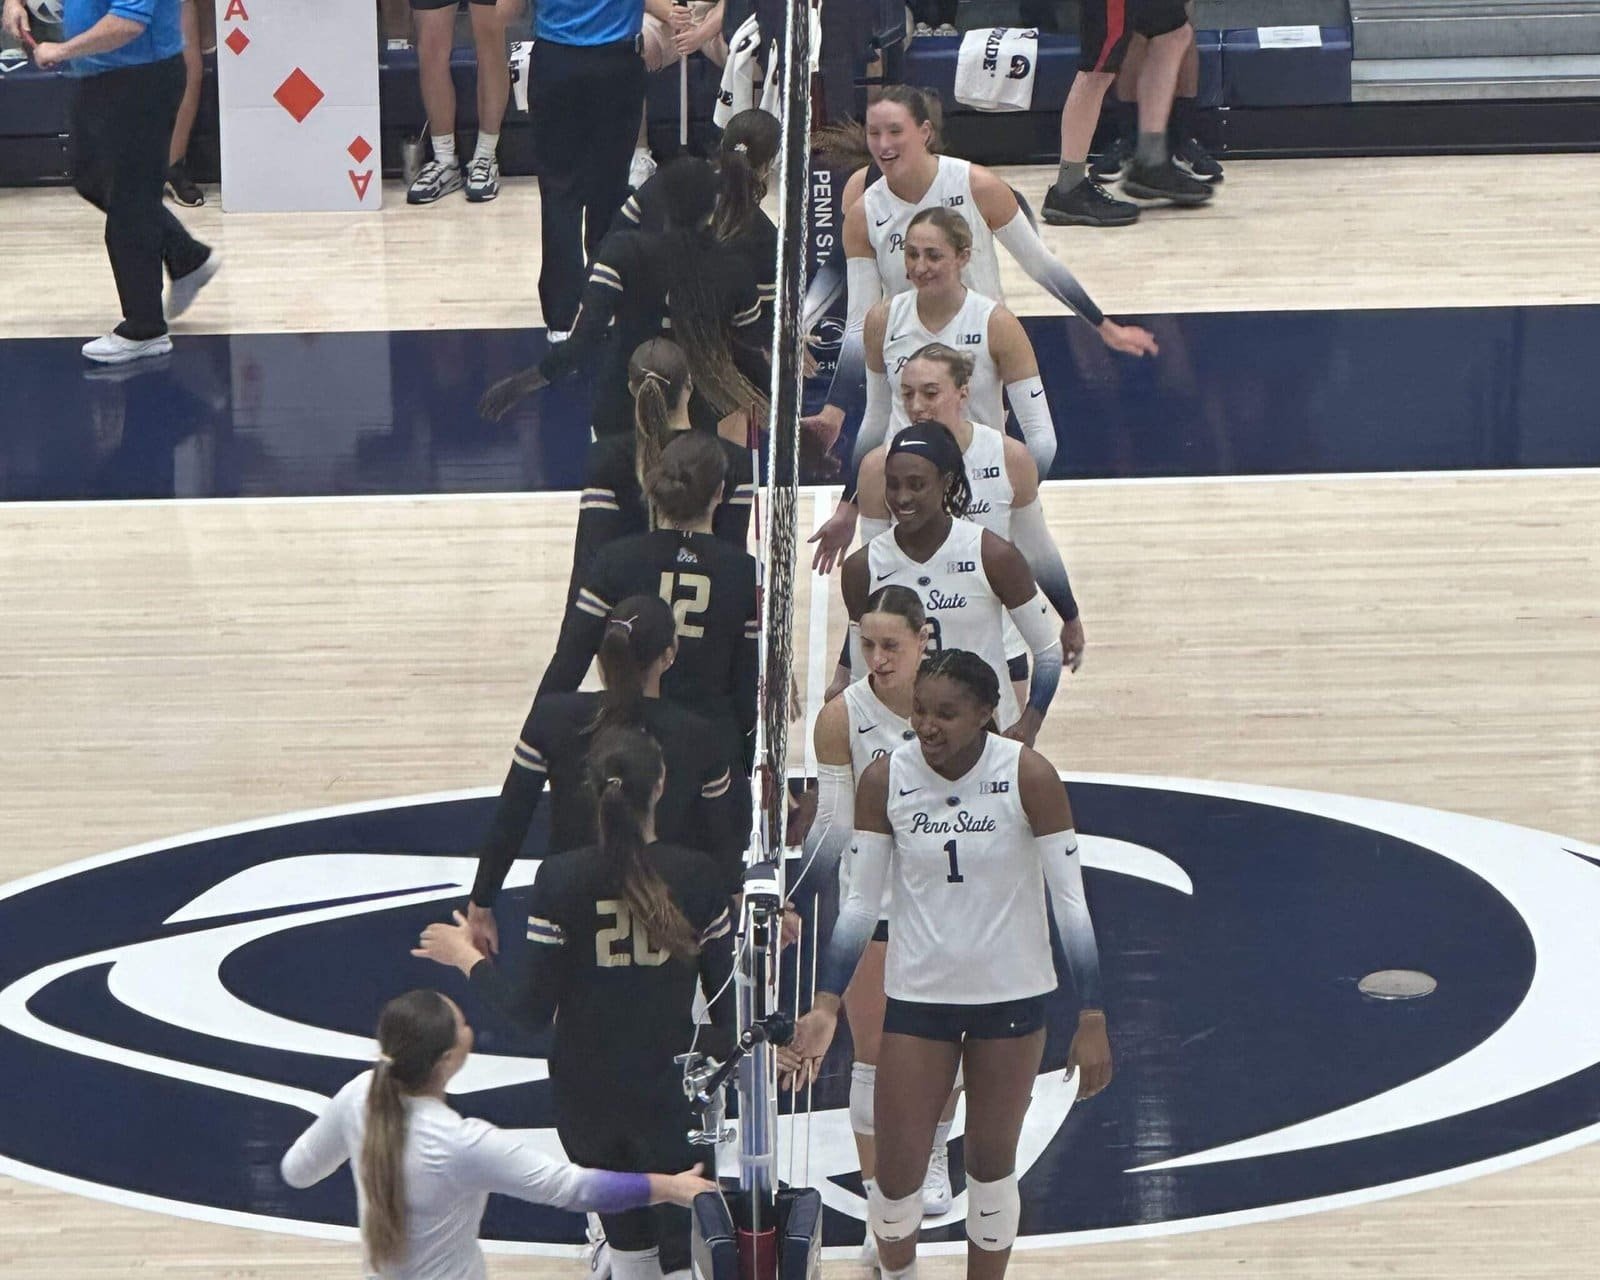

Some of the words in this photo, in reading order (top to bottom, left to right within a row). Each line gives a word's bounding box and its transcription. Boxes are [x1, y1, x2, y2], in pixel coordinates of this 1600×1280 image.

[224, 0, 249, 21] A
[348, 169, 373, 202] A
[812, 170, 832, 228] PENN
[926, 589, 967, 611] State
[910, 811, 951, 834] Penn
[952, 810, 997, 834] State
[943, 839, 964, 883] 1
